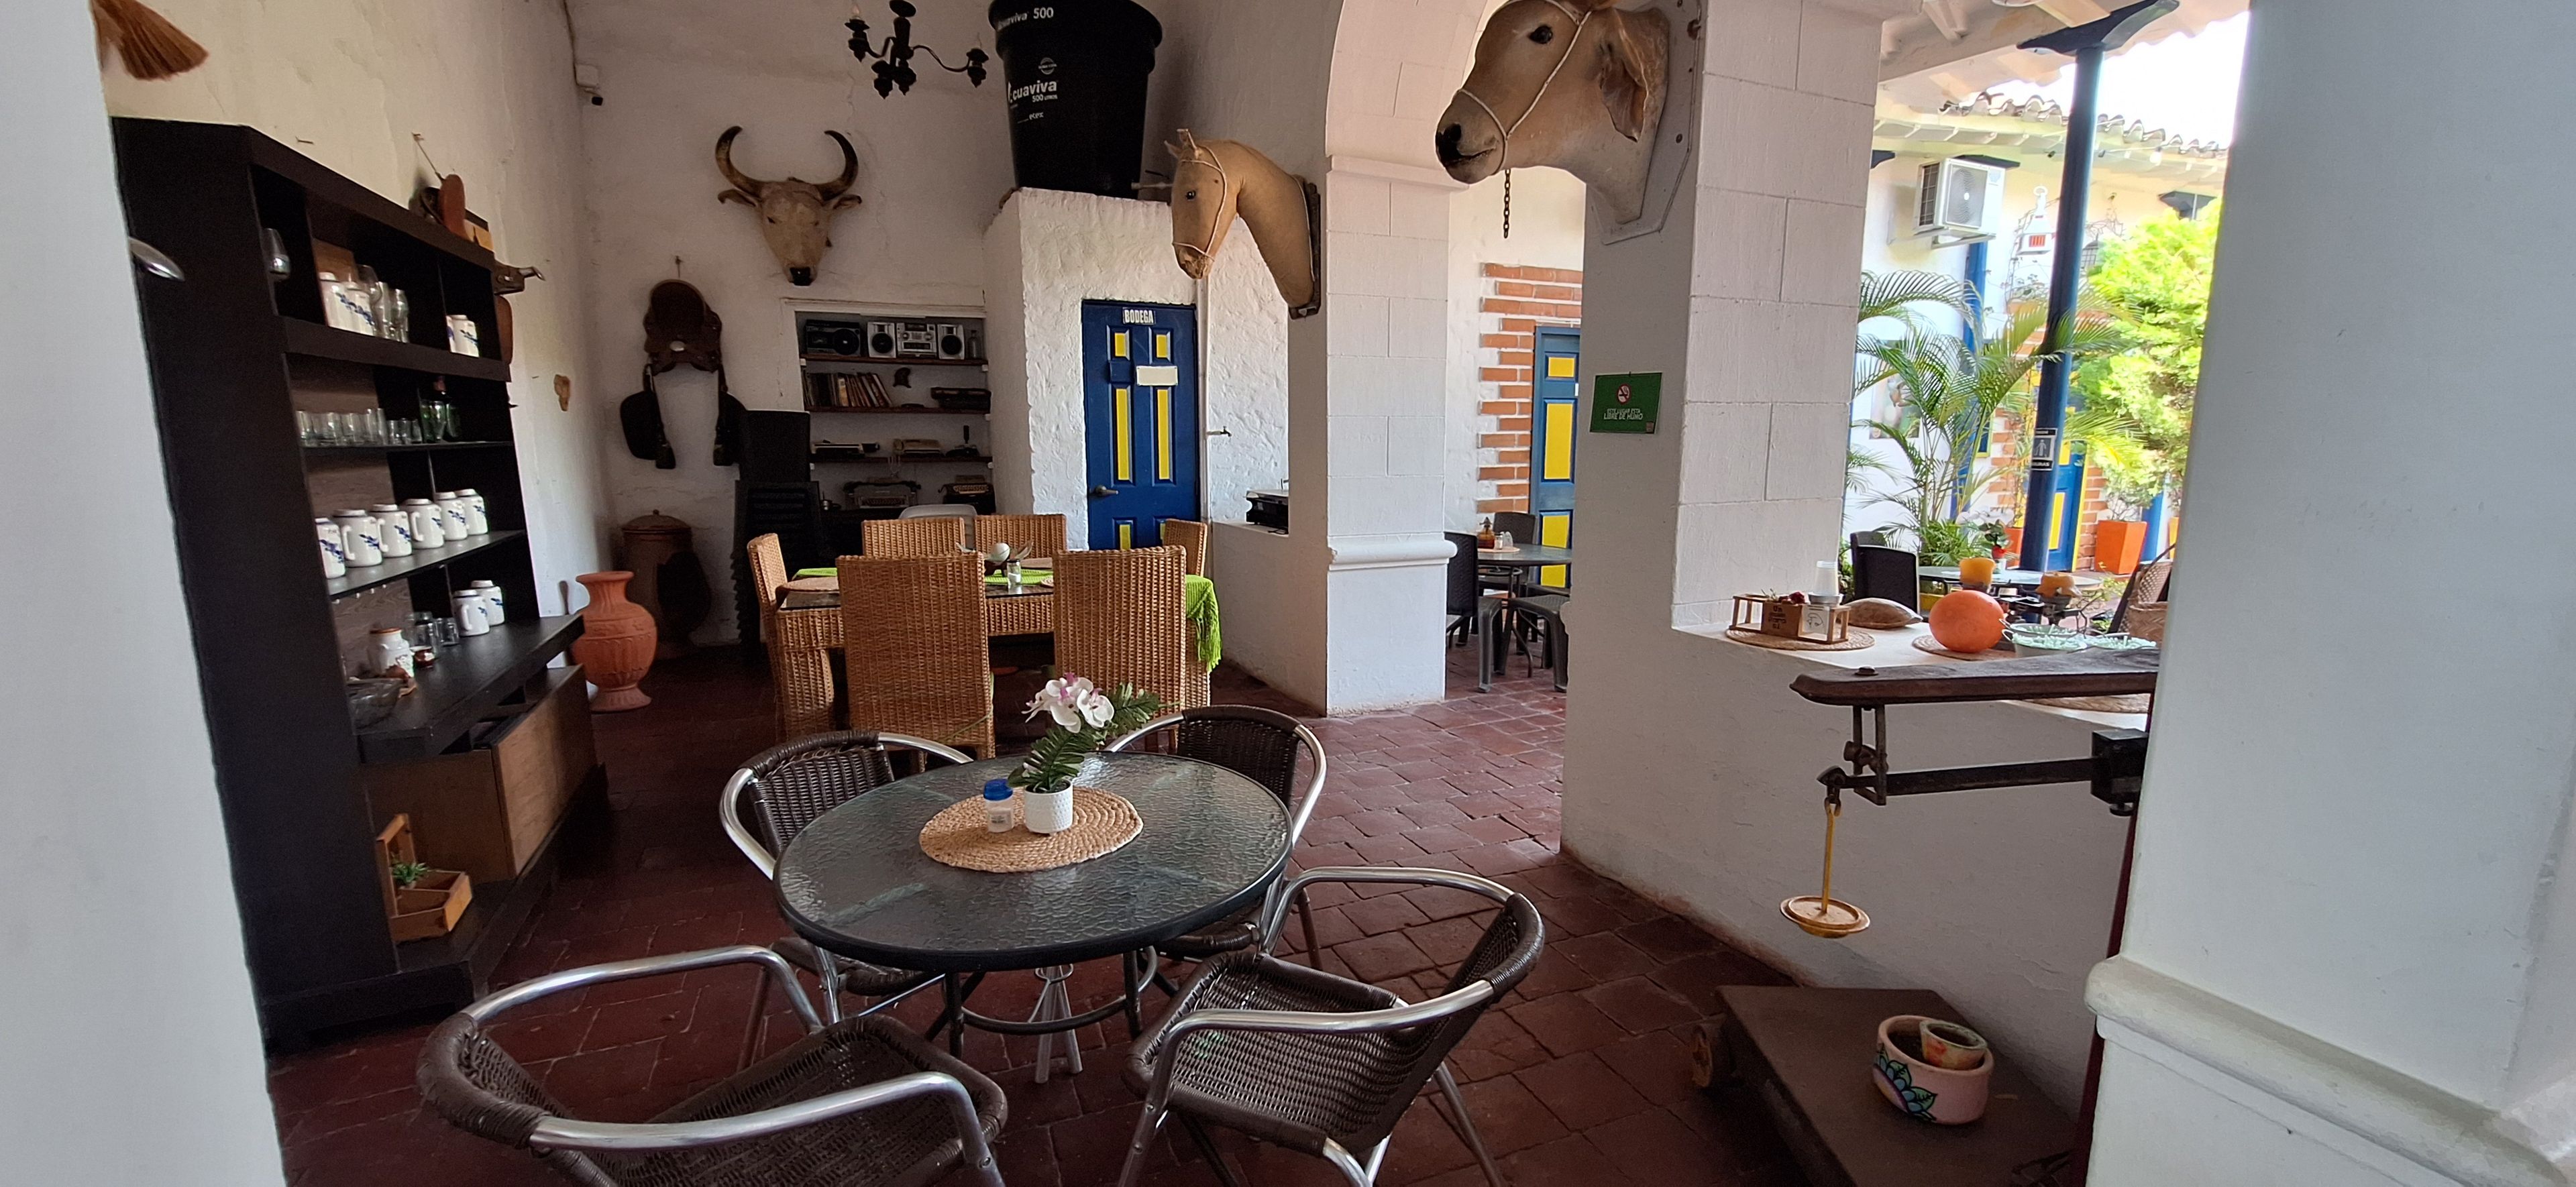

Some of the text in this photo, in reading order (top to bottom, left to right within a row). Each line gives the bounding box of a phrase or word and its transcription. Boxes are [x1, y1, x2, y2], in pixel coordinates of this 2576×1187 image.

[1033, 7, 1054, 19] 500
[1032, 94, 1044, 103] 500
[1124, 309, 1154, 323] BODEGA
[1627, 412, 1644, 420] HUMO
